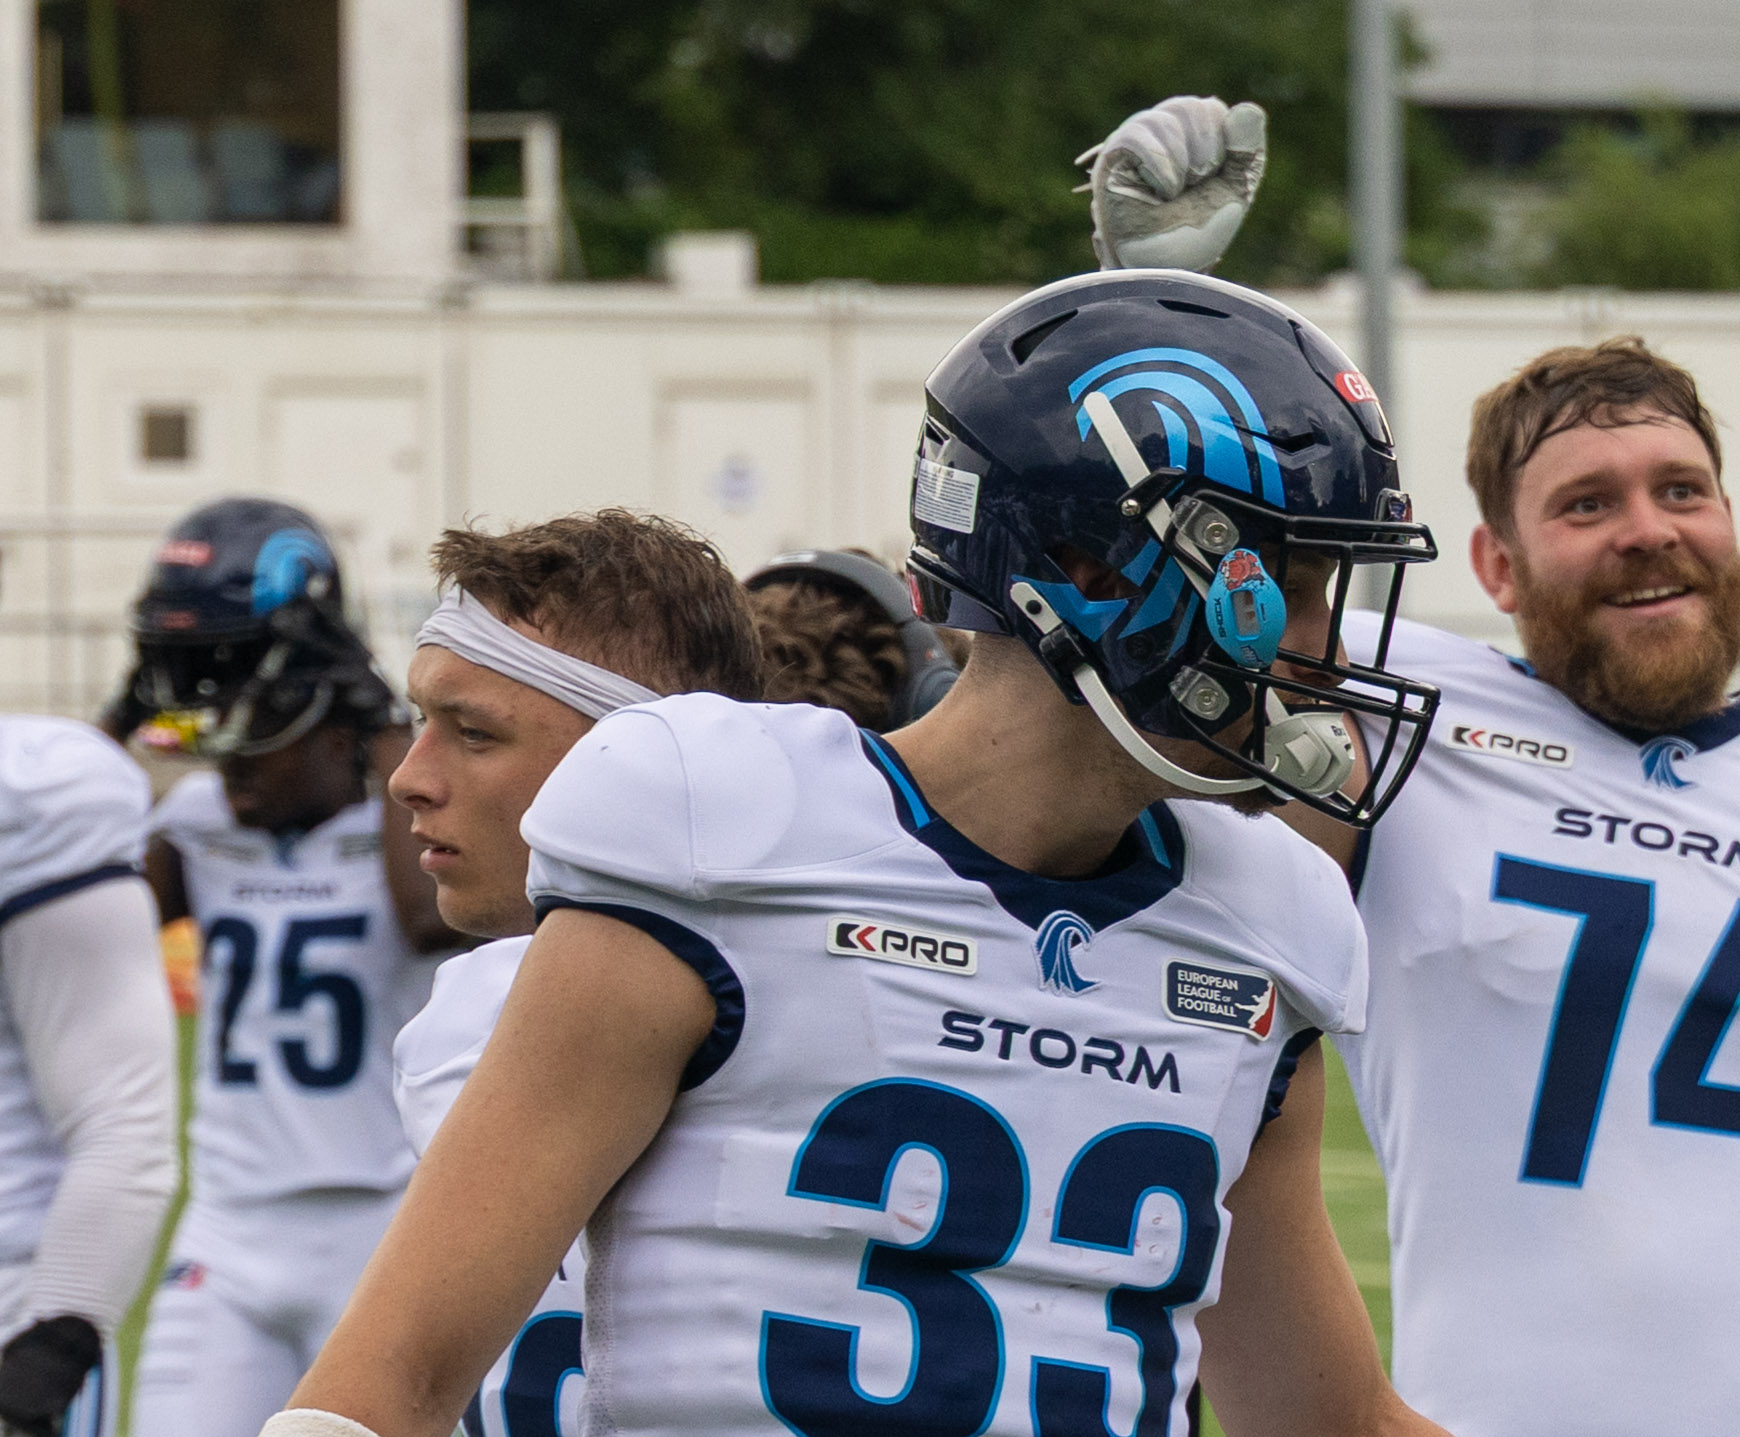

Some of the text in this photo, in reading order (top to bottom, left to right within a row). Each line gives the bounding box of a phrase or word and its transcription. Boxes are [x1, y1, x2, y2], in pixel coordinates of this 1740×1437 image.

[1213, 597, 1228, 636] SHOCK
[1176, 968, 1239, 991] EUROPEAN
[1176, 983, 1221, 1003] LEAGUE
[203, 913, 370, 1091] 25
[1176, 996, 1238, 1018] FOOTBALL
[938, 1009, 1181, 1094] STORM
